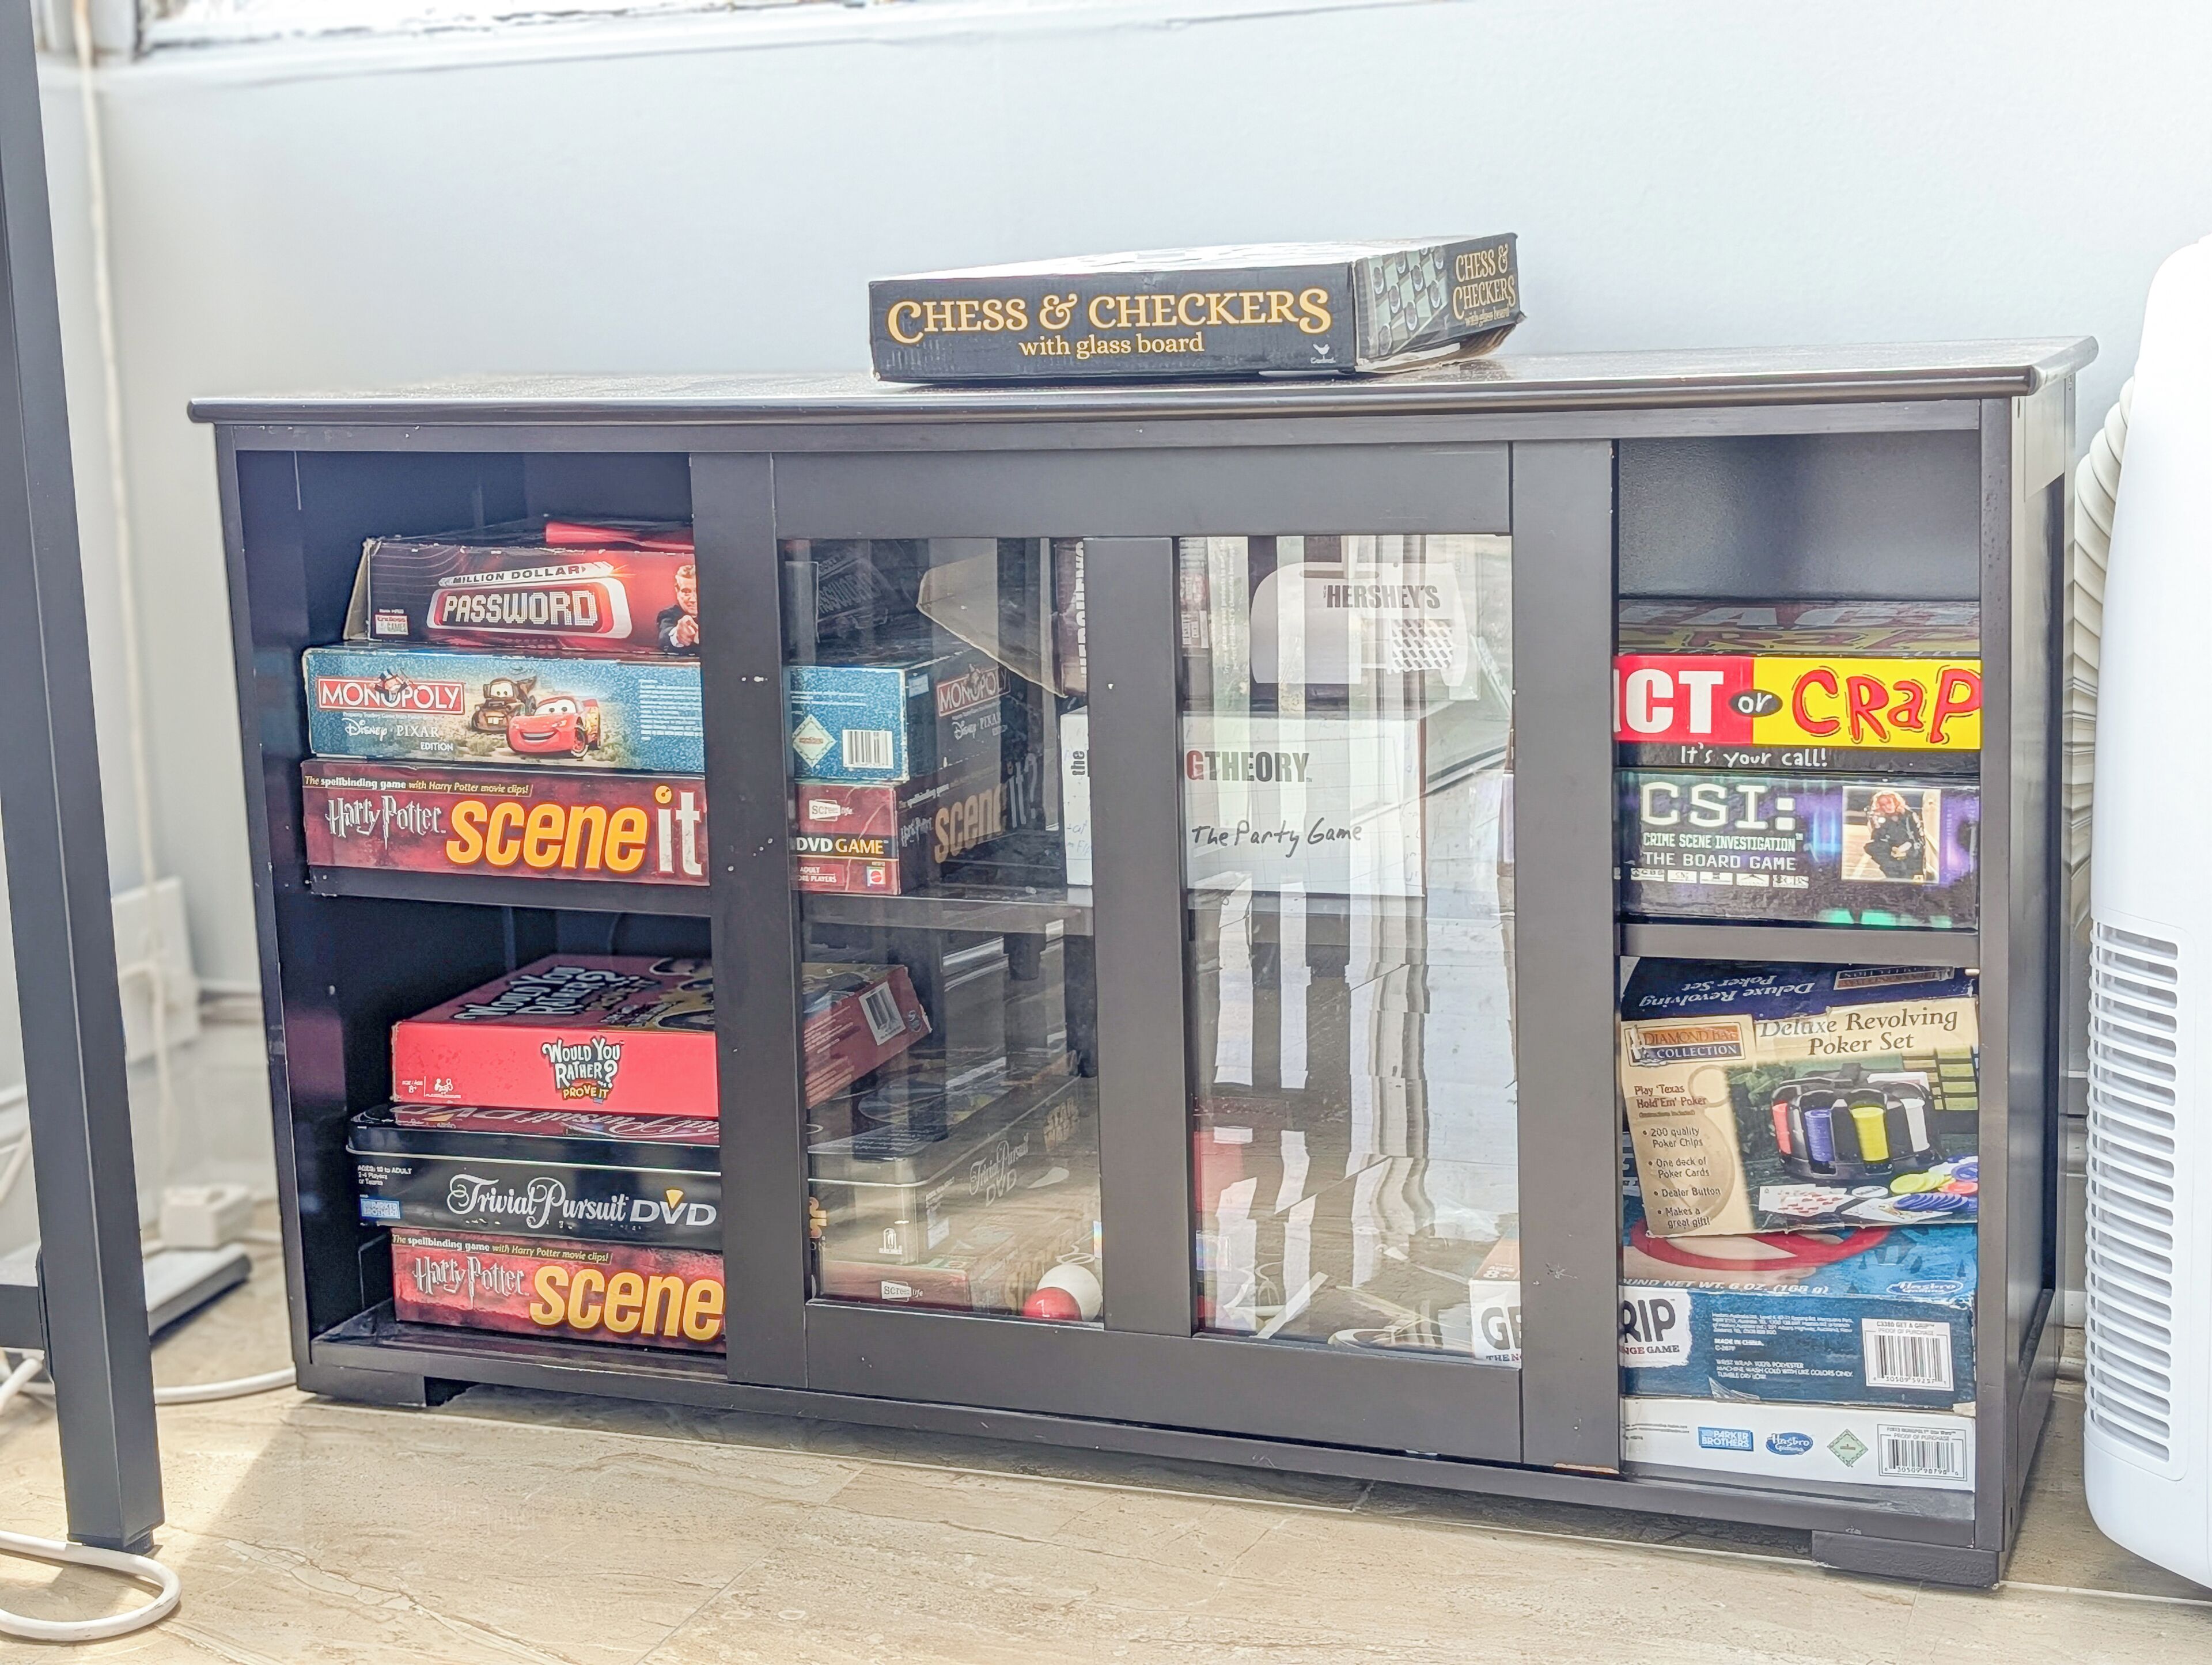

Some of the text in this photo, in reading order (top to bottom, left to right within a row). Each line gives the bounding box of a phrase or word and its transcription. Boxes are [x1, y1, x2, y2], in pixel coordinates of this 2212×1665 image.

[1456, 243, 1509, 282] CHESS &
[1453, 275, 1516, 320] CHECKERS
[888, 287, 1332, 344] CHESS & CHECKERS
[1018, 331, 1205, 359] with glass board
[453, 565, 579, 584] MILLION DOLLAR
[1327, 585, 1441, 609] HERSHEY'S
[442, 590, 598, 626] PASSWORD
[322, 682, 459, 709] MONOPOLY
[940, 668, 1008, 712] MONOPOLY
[1613, 668, 1724, 734] CT
[1738, 692, 1772, 714] or
[397, 725, 440, 738] PIXAR
[421, 742, 454, 751] EDITION
[1680, 742, 1828, 768] It's your call!
[1072, 750, 1085, 776] the
[305, 776, 529, 795] The spellbinding game with Harry Potter movie clips!
[1640, 781, 1796, 831] CSI:
[325, 785, 703, 877] Harry Potter scene it
[1192, 817, 1363, 858] The Party Game
[796, 837, 884, 854] DVD GAME
[1643, 832, 1796, 852] CRIME SCENE INVESTIGATION
[1645, 852, 1796, 871] THE BOARD GAME
[1681, 975, 1778, 992] Poker Set
[1639, 982, 1816, 1009] Deluxe Revolving
[1760, 1007, 1958, 1038] Deluxe Revolving
[1644, 1030, 1709, 1045] DIAMOND
[1808, 1033, 1915, 1057] Poker Set
[542, 1038, 620, 1063] WOULD YOU
[1657, 1045, 1737, 1059] COLLECTION
[563, 1085, 609, 1098] PROVE IT
[1634, 1086, 1653, 1096] Play
[1637, 1098, 1658, 1108] Hold
[1681, 1096, 1707, 1106] Poker
[1651, 1127, 1699, 1139] 200 quality
[1653, 1137, 1703, 1148] Poker Chips
[1656, 1156, 1707, 1167] One deck of
[1658, 1168, 1710, 1179] Poker Cards
[1662, 1186, 1721, 1197] Dealer Button
[447, 1174, 716, 1229] Trivial Pursuit DVD
[1665, 1207, 1692, 1216] Makes
[1668, 1218, 1690, 1229] great
[392, 1234, 609, 1262] The spellbinding game with Harry Potter movie clips!
[1699, 1281, 1725, 1289] WT.
[412, 1256, 724, 1340] Harry Potter scene
[1036, 1299, 1050, 1317] 1
[1646, 1345, 1680, 1354] GAME
[1702, 1436, 1750, 1448] BROTHERS
[1713, 1430, 1749, 1440] PARKER
[1767, 1433, 1810, 1447] Hasbro
